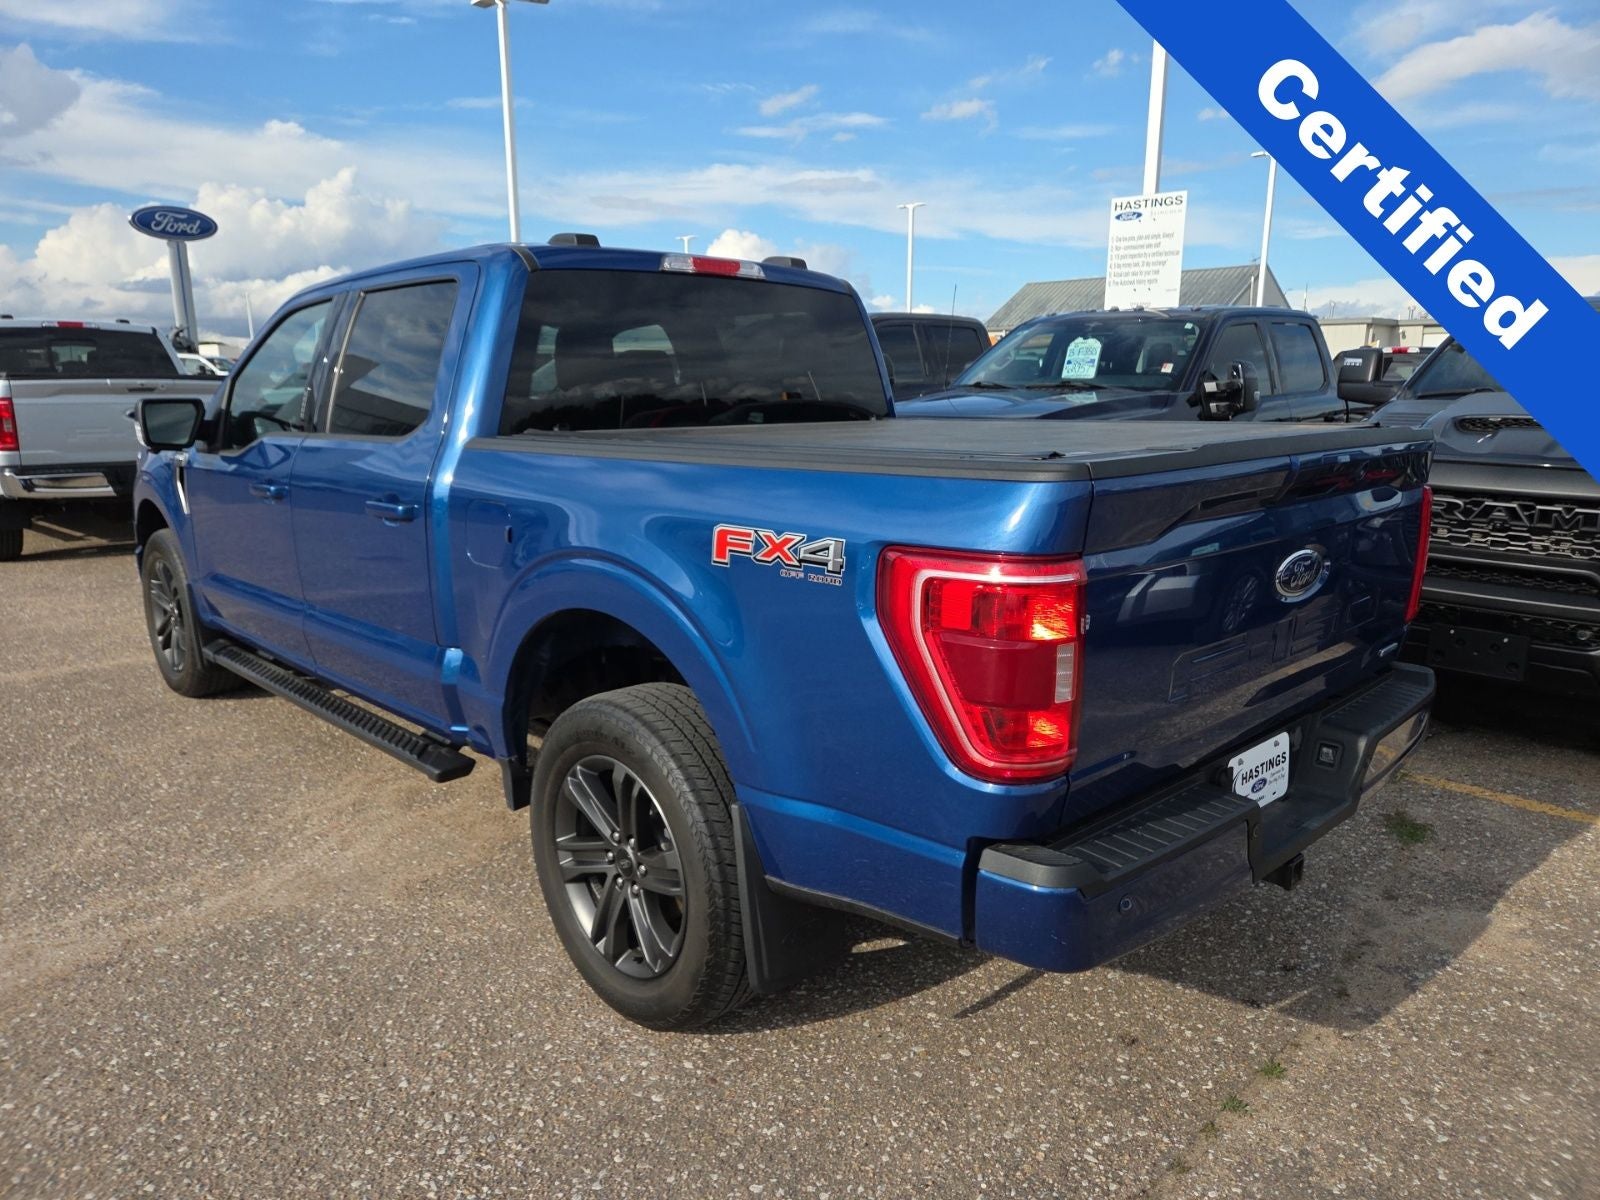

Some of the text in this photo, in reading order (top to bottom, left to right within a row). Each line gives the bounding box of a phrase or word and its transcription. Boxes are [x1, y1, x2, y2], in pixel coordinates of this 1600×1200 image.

[1114, 195, 1184, 211] HASTINGS
[151, 211, 201, 235] Ford
[1431, 496, 1600, 531] RAM
[711, 523, 846, 577] FX4
[1290, 559, 1317, 588] Ford
[1241, 752, 1287, 786] HASTINGS
